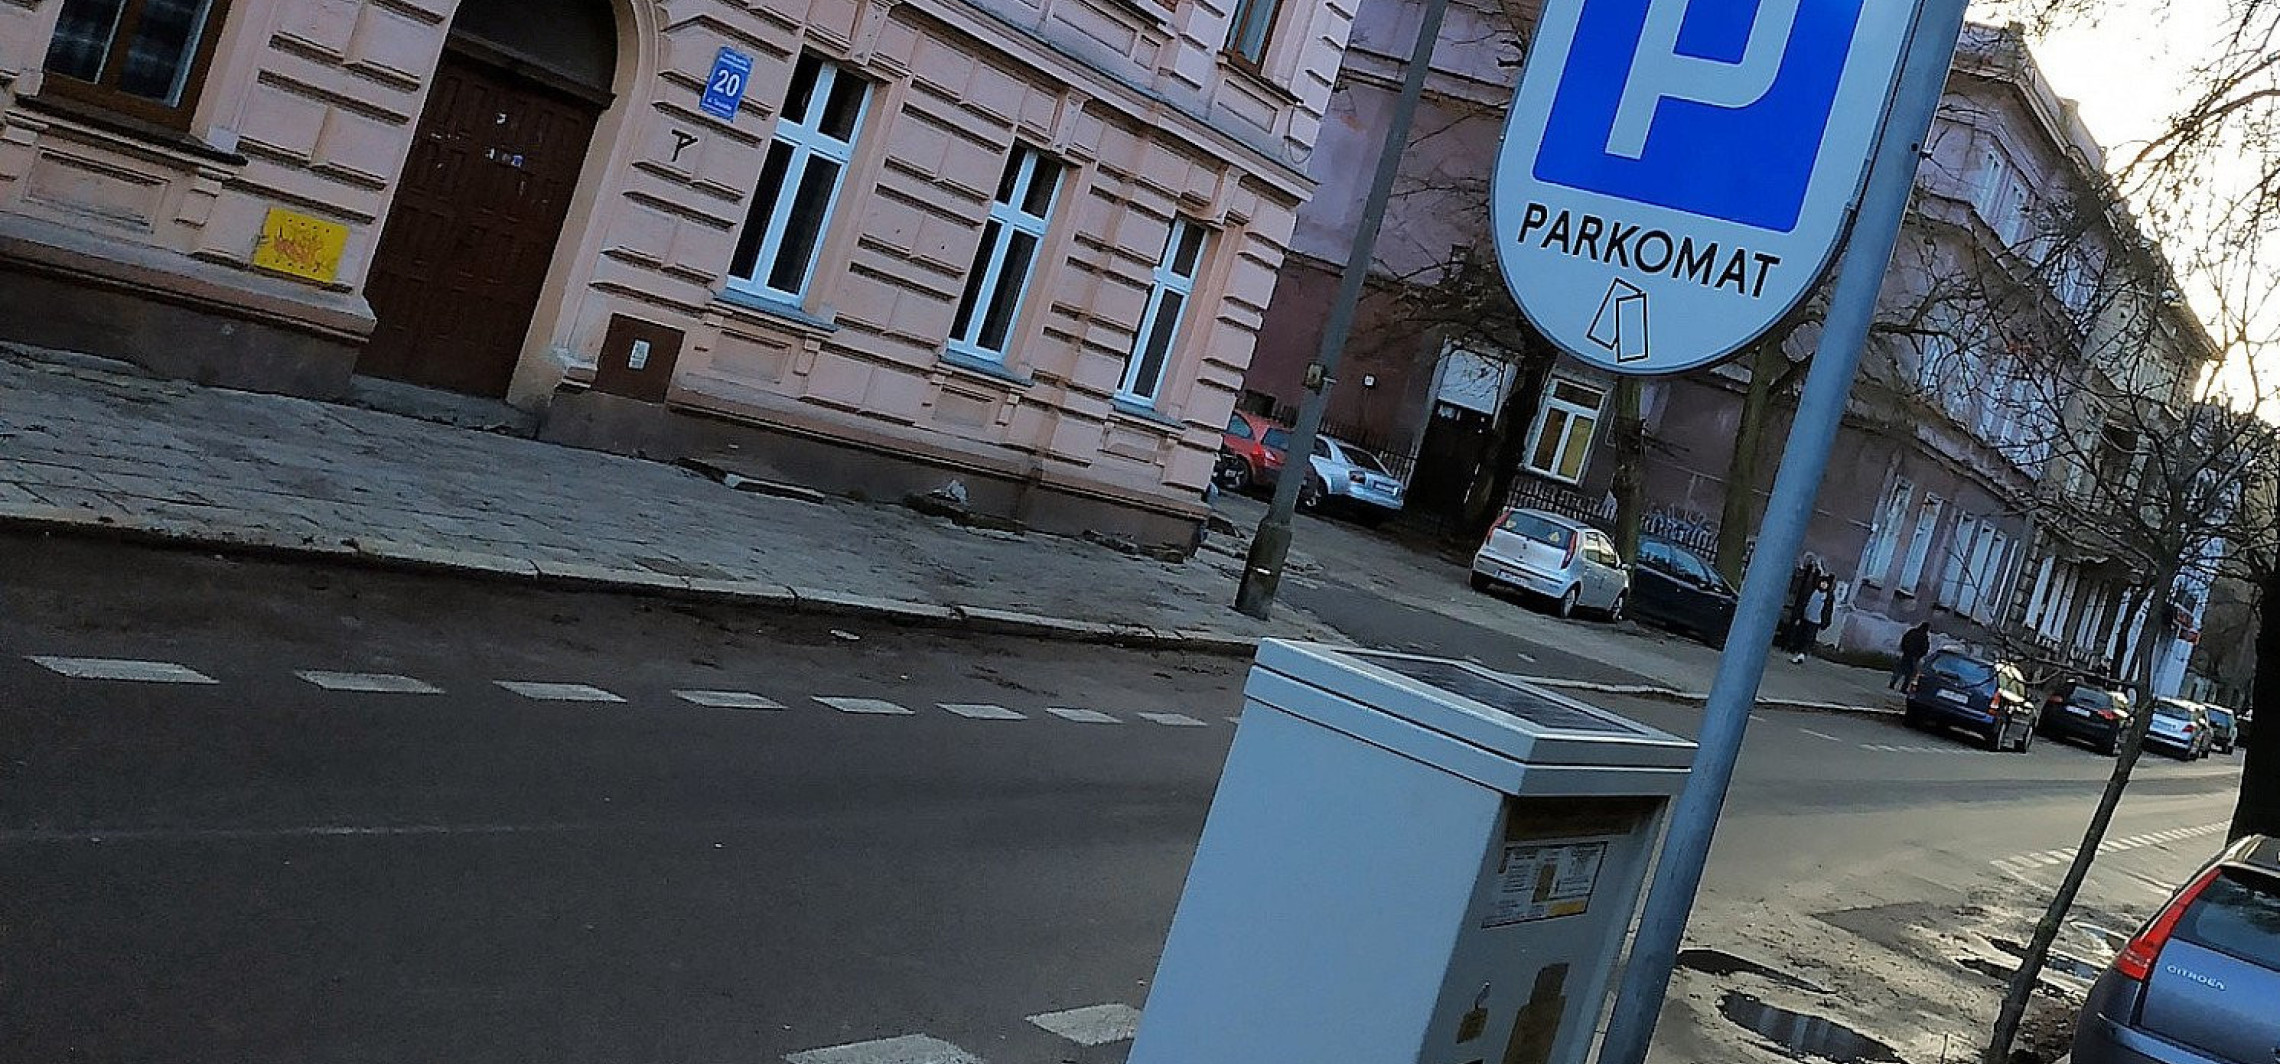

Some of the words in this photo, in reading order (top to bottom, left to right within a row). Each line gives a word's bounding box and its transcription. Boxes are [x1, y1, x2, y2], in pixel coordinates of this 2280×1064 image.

[713, 69, 740, 97] 20
[1605, 0, 1798, 160] P
[1517, 202, 1781, 297] PARKOMAT
